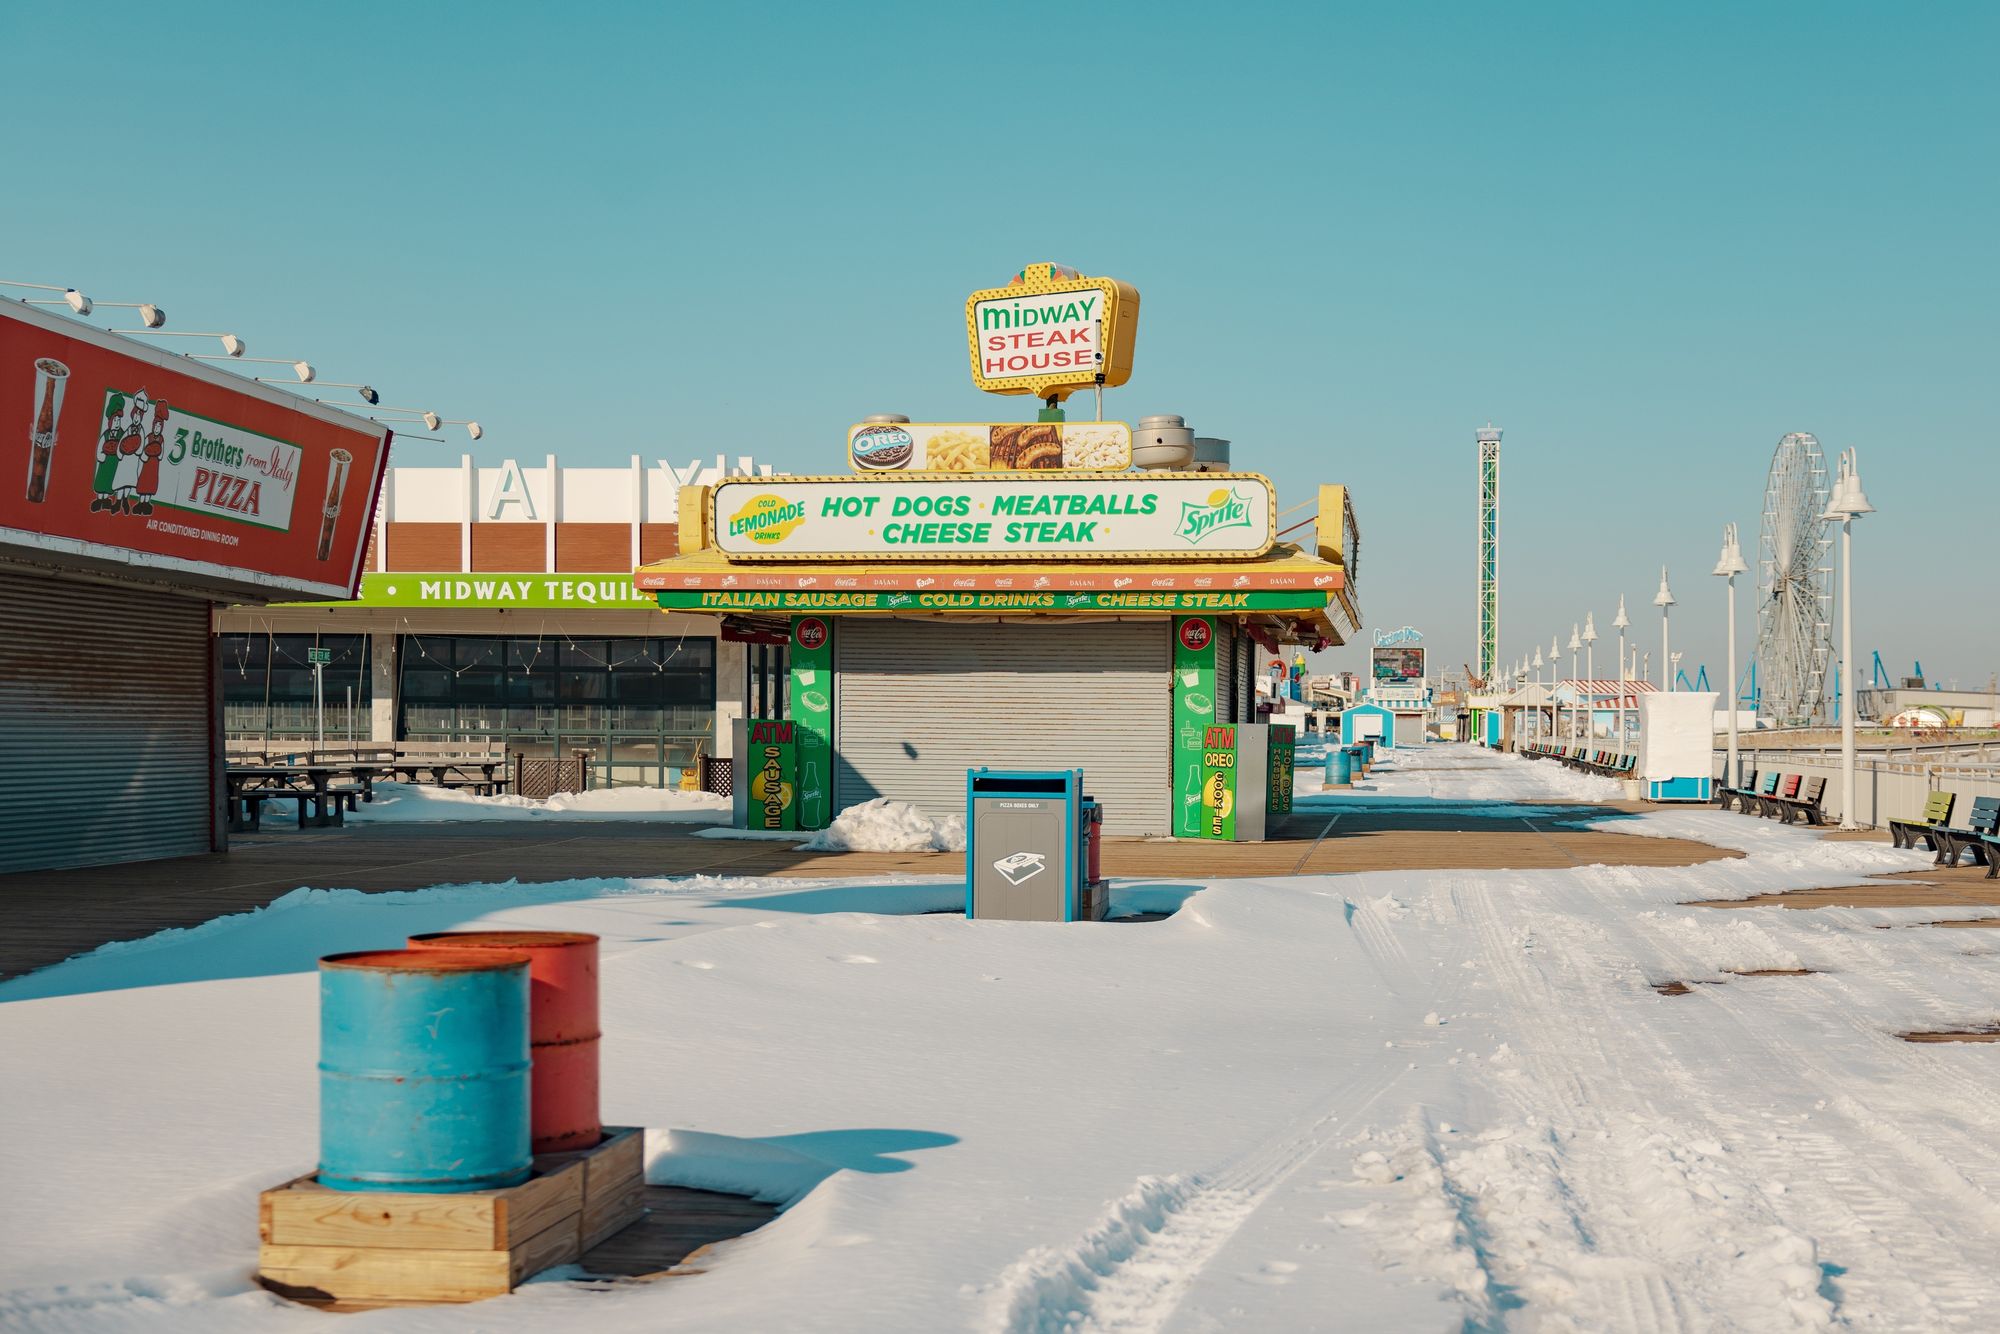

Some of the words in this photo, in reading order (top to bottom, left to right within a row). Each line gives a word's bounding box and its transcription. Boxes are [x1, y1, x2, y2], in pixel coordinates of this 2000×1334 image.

[988, 327, 1091, 351] STEAK
[986, 349, 1093, 373] HOUSE
[854, 431, 910, 452] OREO
[167, 427, 189, 466] 3
[192, 431, 244, 469] Brothers
[243, 453, 267, 470] from
[261, 445, 295, 491] Italy
[188, 467, 263, 516] PIZZA
[487, 458, 535, 520] A
[757, 499, 776, 508] COLD
[821, 496, 880, 517] HOT
[891, 496, 972, 517] DOGS
[991, 493, 1158, 516] MEATBALLS
[729, 501, 805, 537] LEMONADE
[1183, 499, 1244, 537] Sprite
[146, 519, 158, 531] AIR
[159, 521, 200, 538] CONDITIONED
[201, 530, 221, 543] DINING
[221, 534, 239, 546] ROOM
[754, 532, 781, 541] DRINKS
[882, 522, 992, 544] CHEESE
[1004, 521, 1098, 543] STEAK
[643, 577, 666, 586] Coca-Cola
[798, 576, 817, 588] Fanta
[834, 578, 858, 587] Coca-Cola
[916, 577, 935, 588] Fanta
[953, 578, 976, 587] Coca-Cola
[1113, 577, 1133, 588] Fanta
[1151, 578, 1175, 587] Coca-Cola
[1313, 575, 1333, 586] Fanta
[420, 581, 532, 600] MIDWAY
[543, 581, 652, 603] TEQUIL
[702, 592, 780, 606] ITALIAN
[784, 592, 878, 607] SAUSAGE
[889, 595, 910, 606] Sprite
[919, 593, 978, 607] COLD
[979, 593, 1055, 607] DRINKS
[1067, 594, 1091, 606] Sprite
[1096, 592, 1177, 607] CHEESE
[1181, 593, 1250, 607] STEAK
[751, 722, 793, 745] ATM
[1204, 727, 1235, 749] ATM
[1273, 727, 1294, 743] ATM
[1204, 752, 1235, 768] OREO
[763, 746, 782, 828] SAUSAGE
[1272, 748, 1281, 811] HAMBURGERS
[1212, 771, 1224, 836] COOKIES
